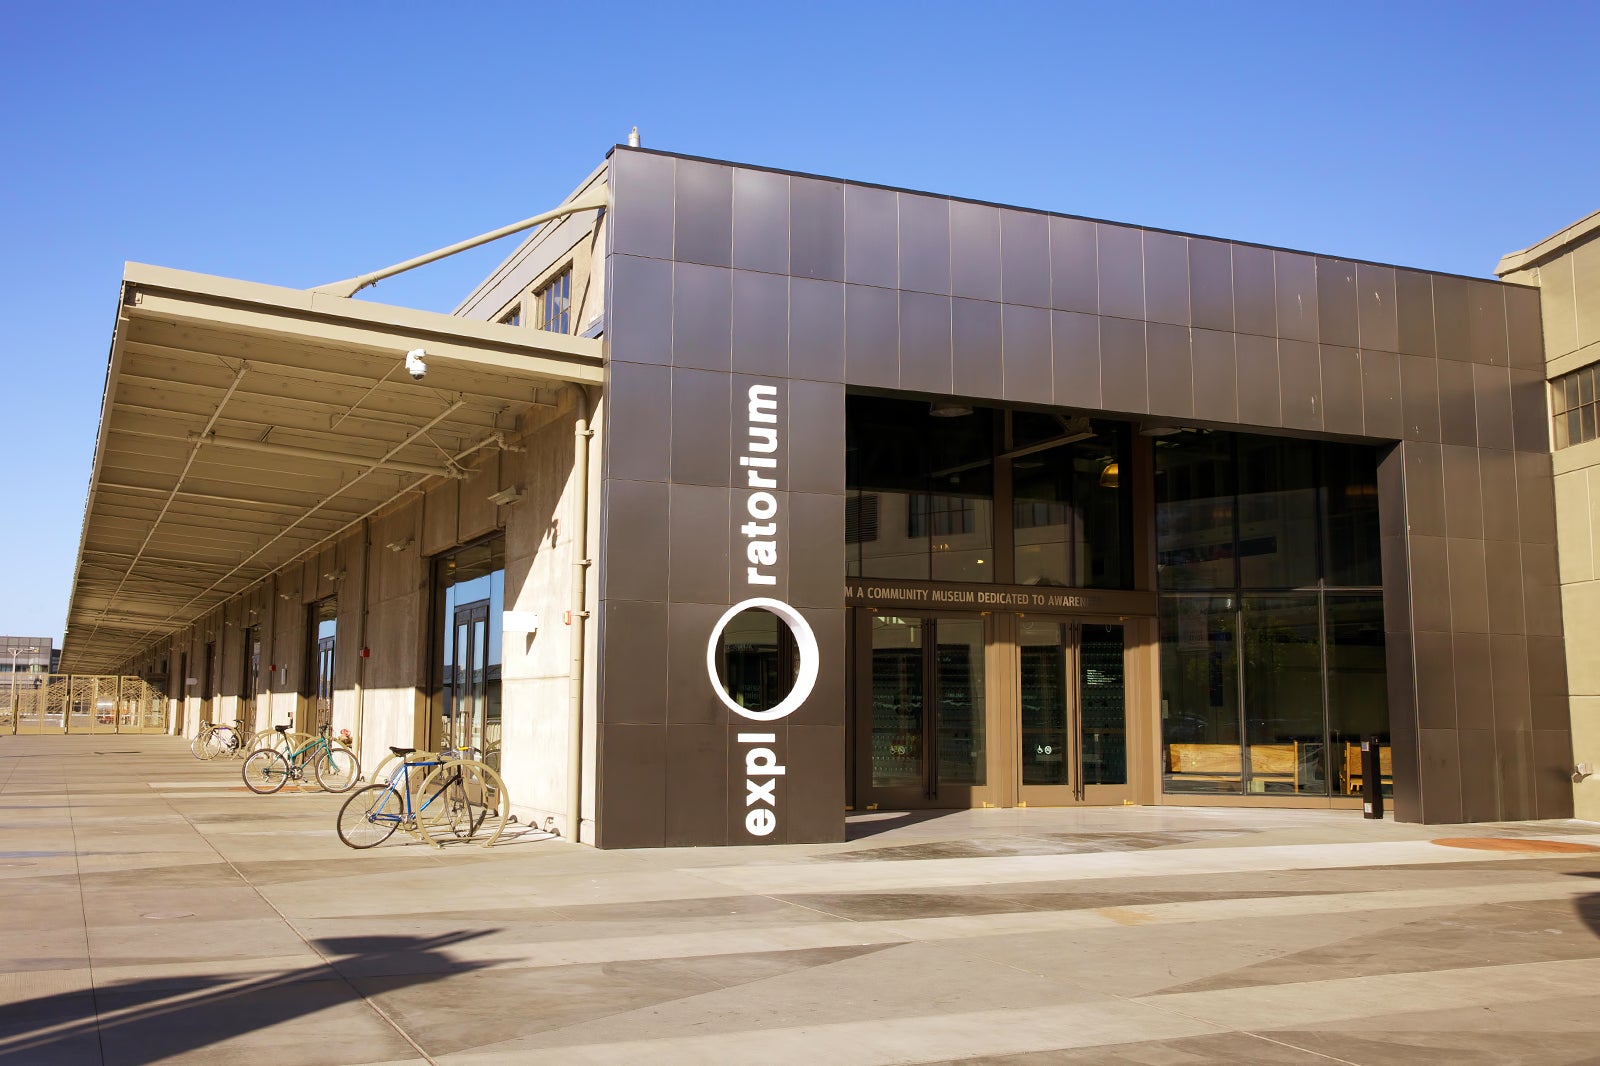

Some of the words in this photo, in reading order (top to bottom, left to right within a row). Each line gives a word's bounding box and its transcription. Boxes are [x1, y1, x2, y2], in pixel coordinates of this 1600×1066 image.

[857, 587, 865, 598] A
[867, 587, 929, 601] COMMUNITY
[932, 590, 975, 603] MUSEUM
[977, 592, 1030, 605] DEDICATED
[1032, 594, 1046, 606] TO
